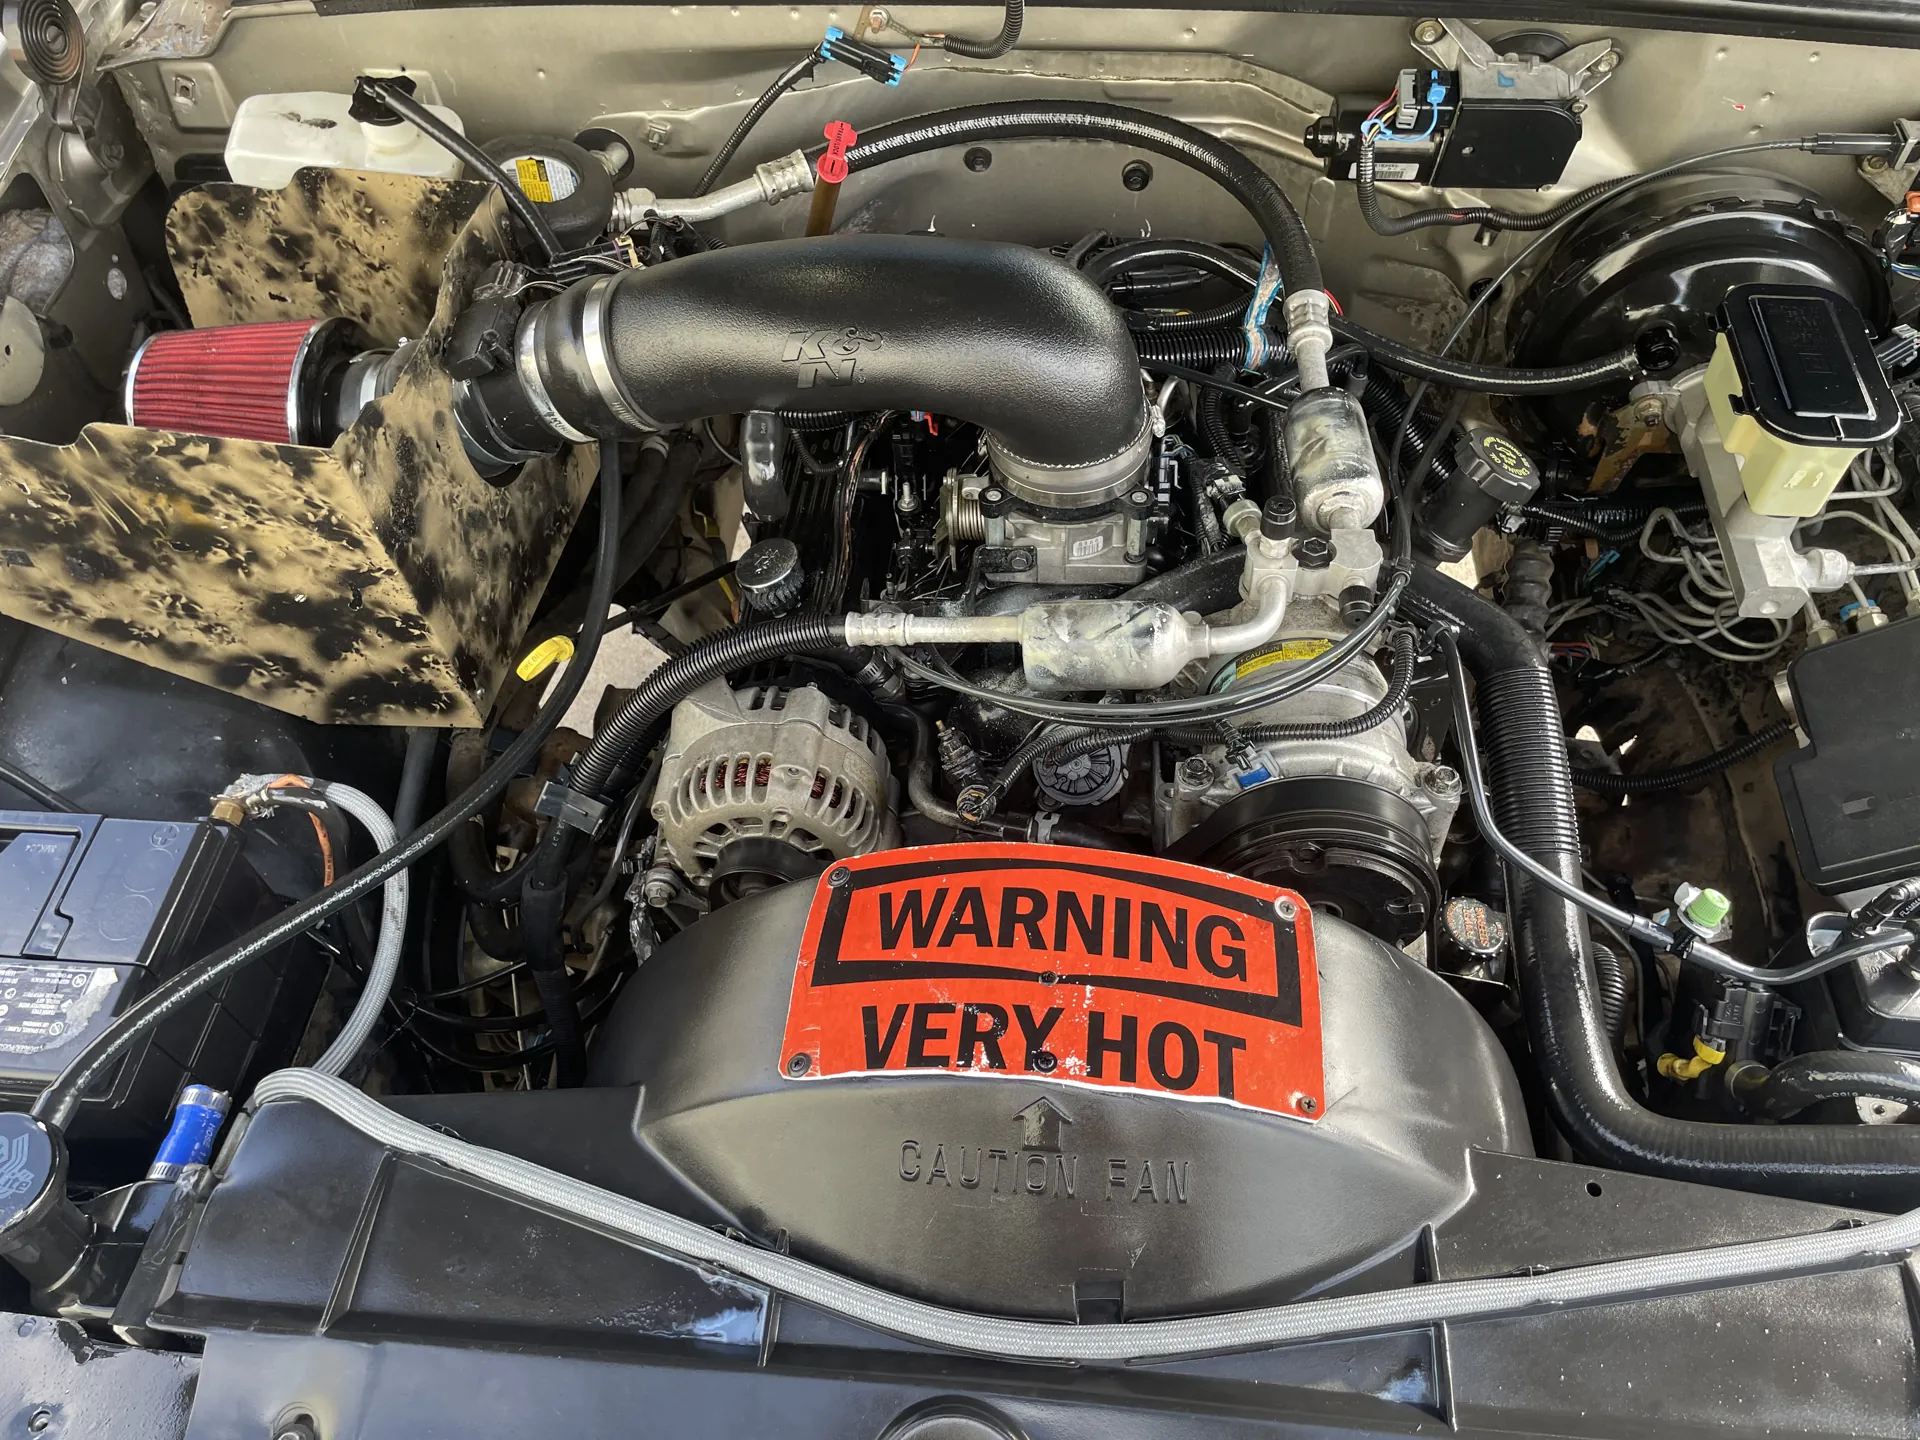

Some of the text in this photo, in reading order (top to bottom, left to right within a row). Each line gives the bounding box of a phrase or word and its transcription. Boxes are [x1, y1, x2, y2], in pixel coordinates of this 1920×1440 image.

[1489, 452, 1501, 464] OIL
[1245, 645, 1280, 661] CAUTION
[879, 886, 1247, 982] WARNING
[861, 1003, 1247, 1099] VERY HOT
[202, 1122, 216, 1148] HOSE
[899, 1139, 1191, 1204] CAUTION FAN
